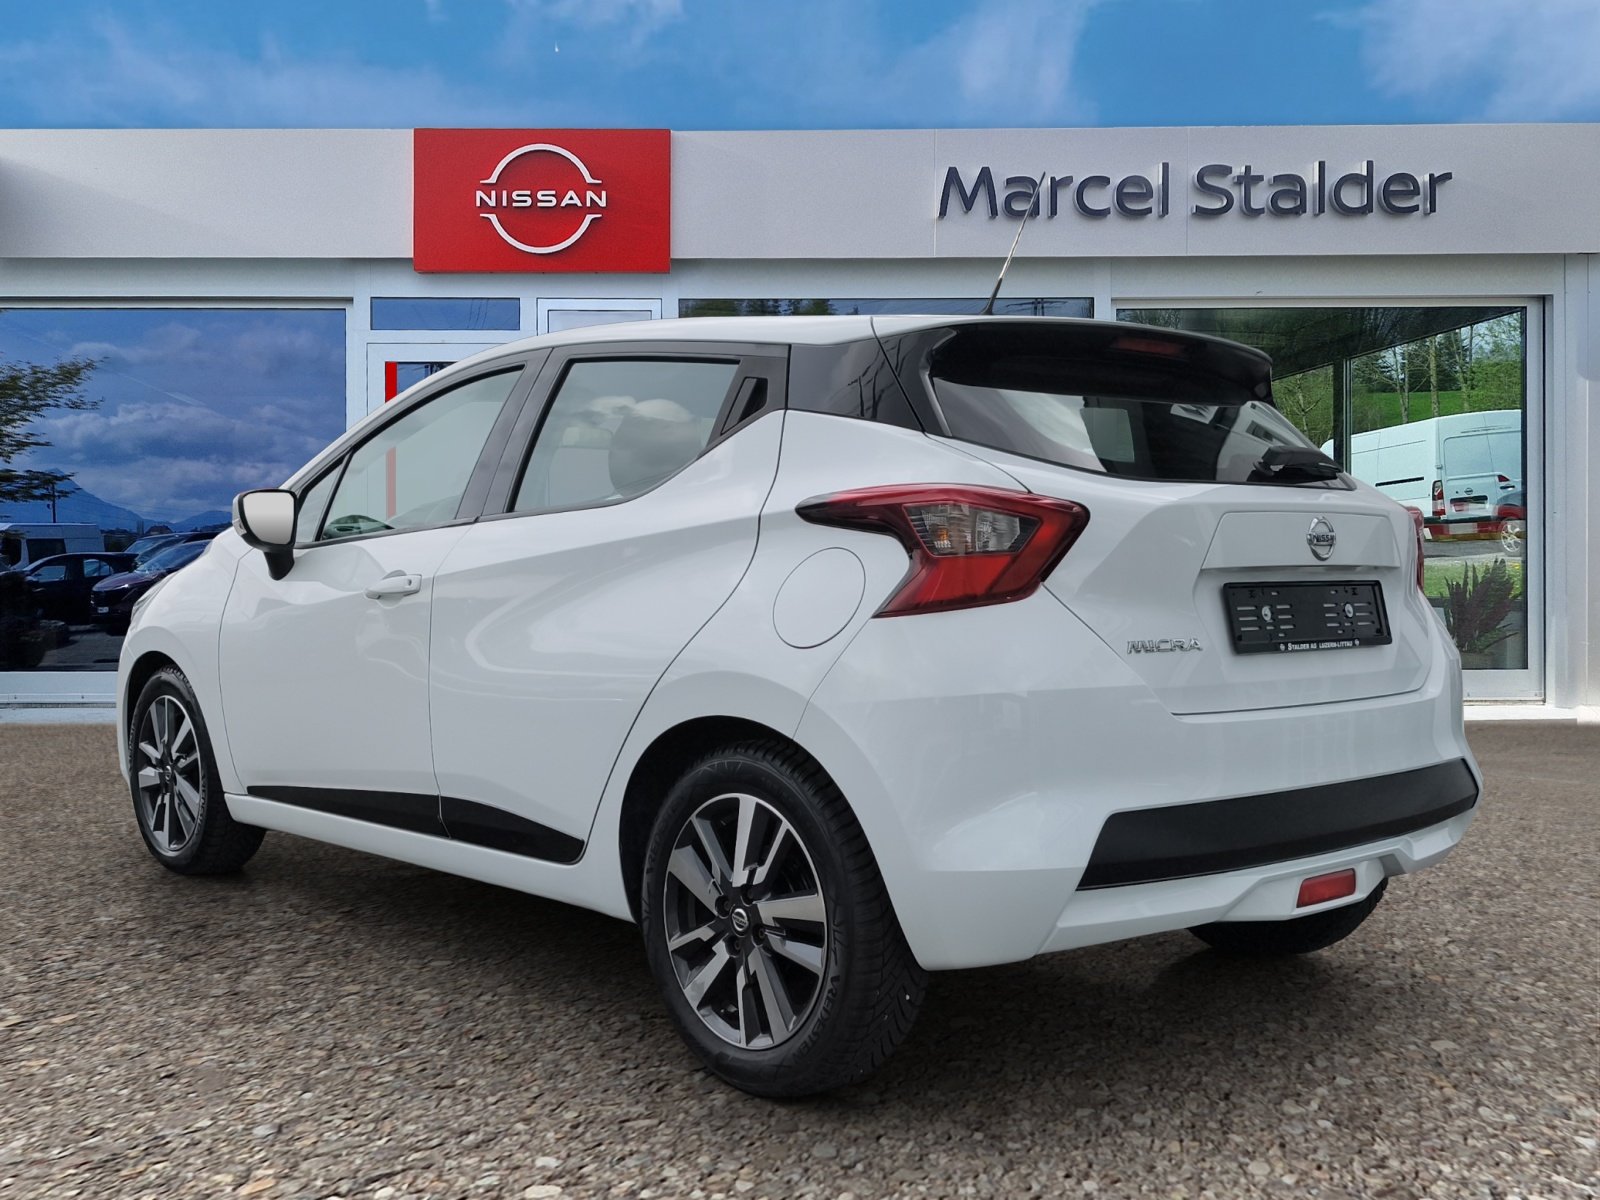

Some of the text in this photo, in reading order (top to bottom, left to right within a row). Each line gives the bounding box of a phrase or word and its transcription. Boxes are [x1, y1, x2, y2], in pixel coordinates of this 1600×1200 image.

[937, 159, 1453, 220] Marcel Stalder
[475, 189, 607, 208] NISSAN
[1127, 638, 1203, 654] MICRA
[1287, 642, 1310, 651] STALDER
